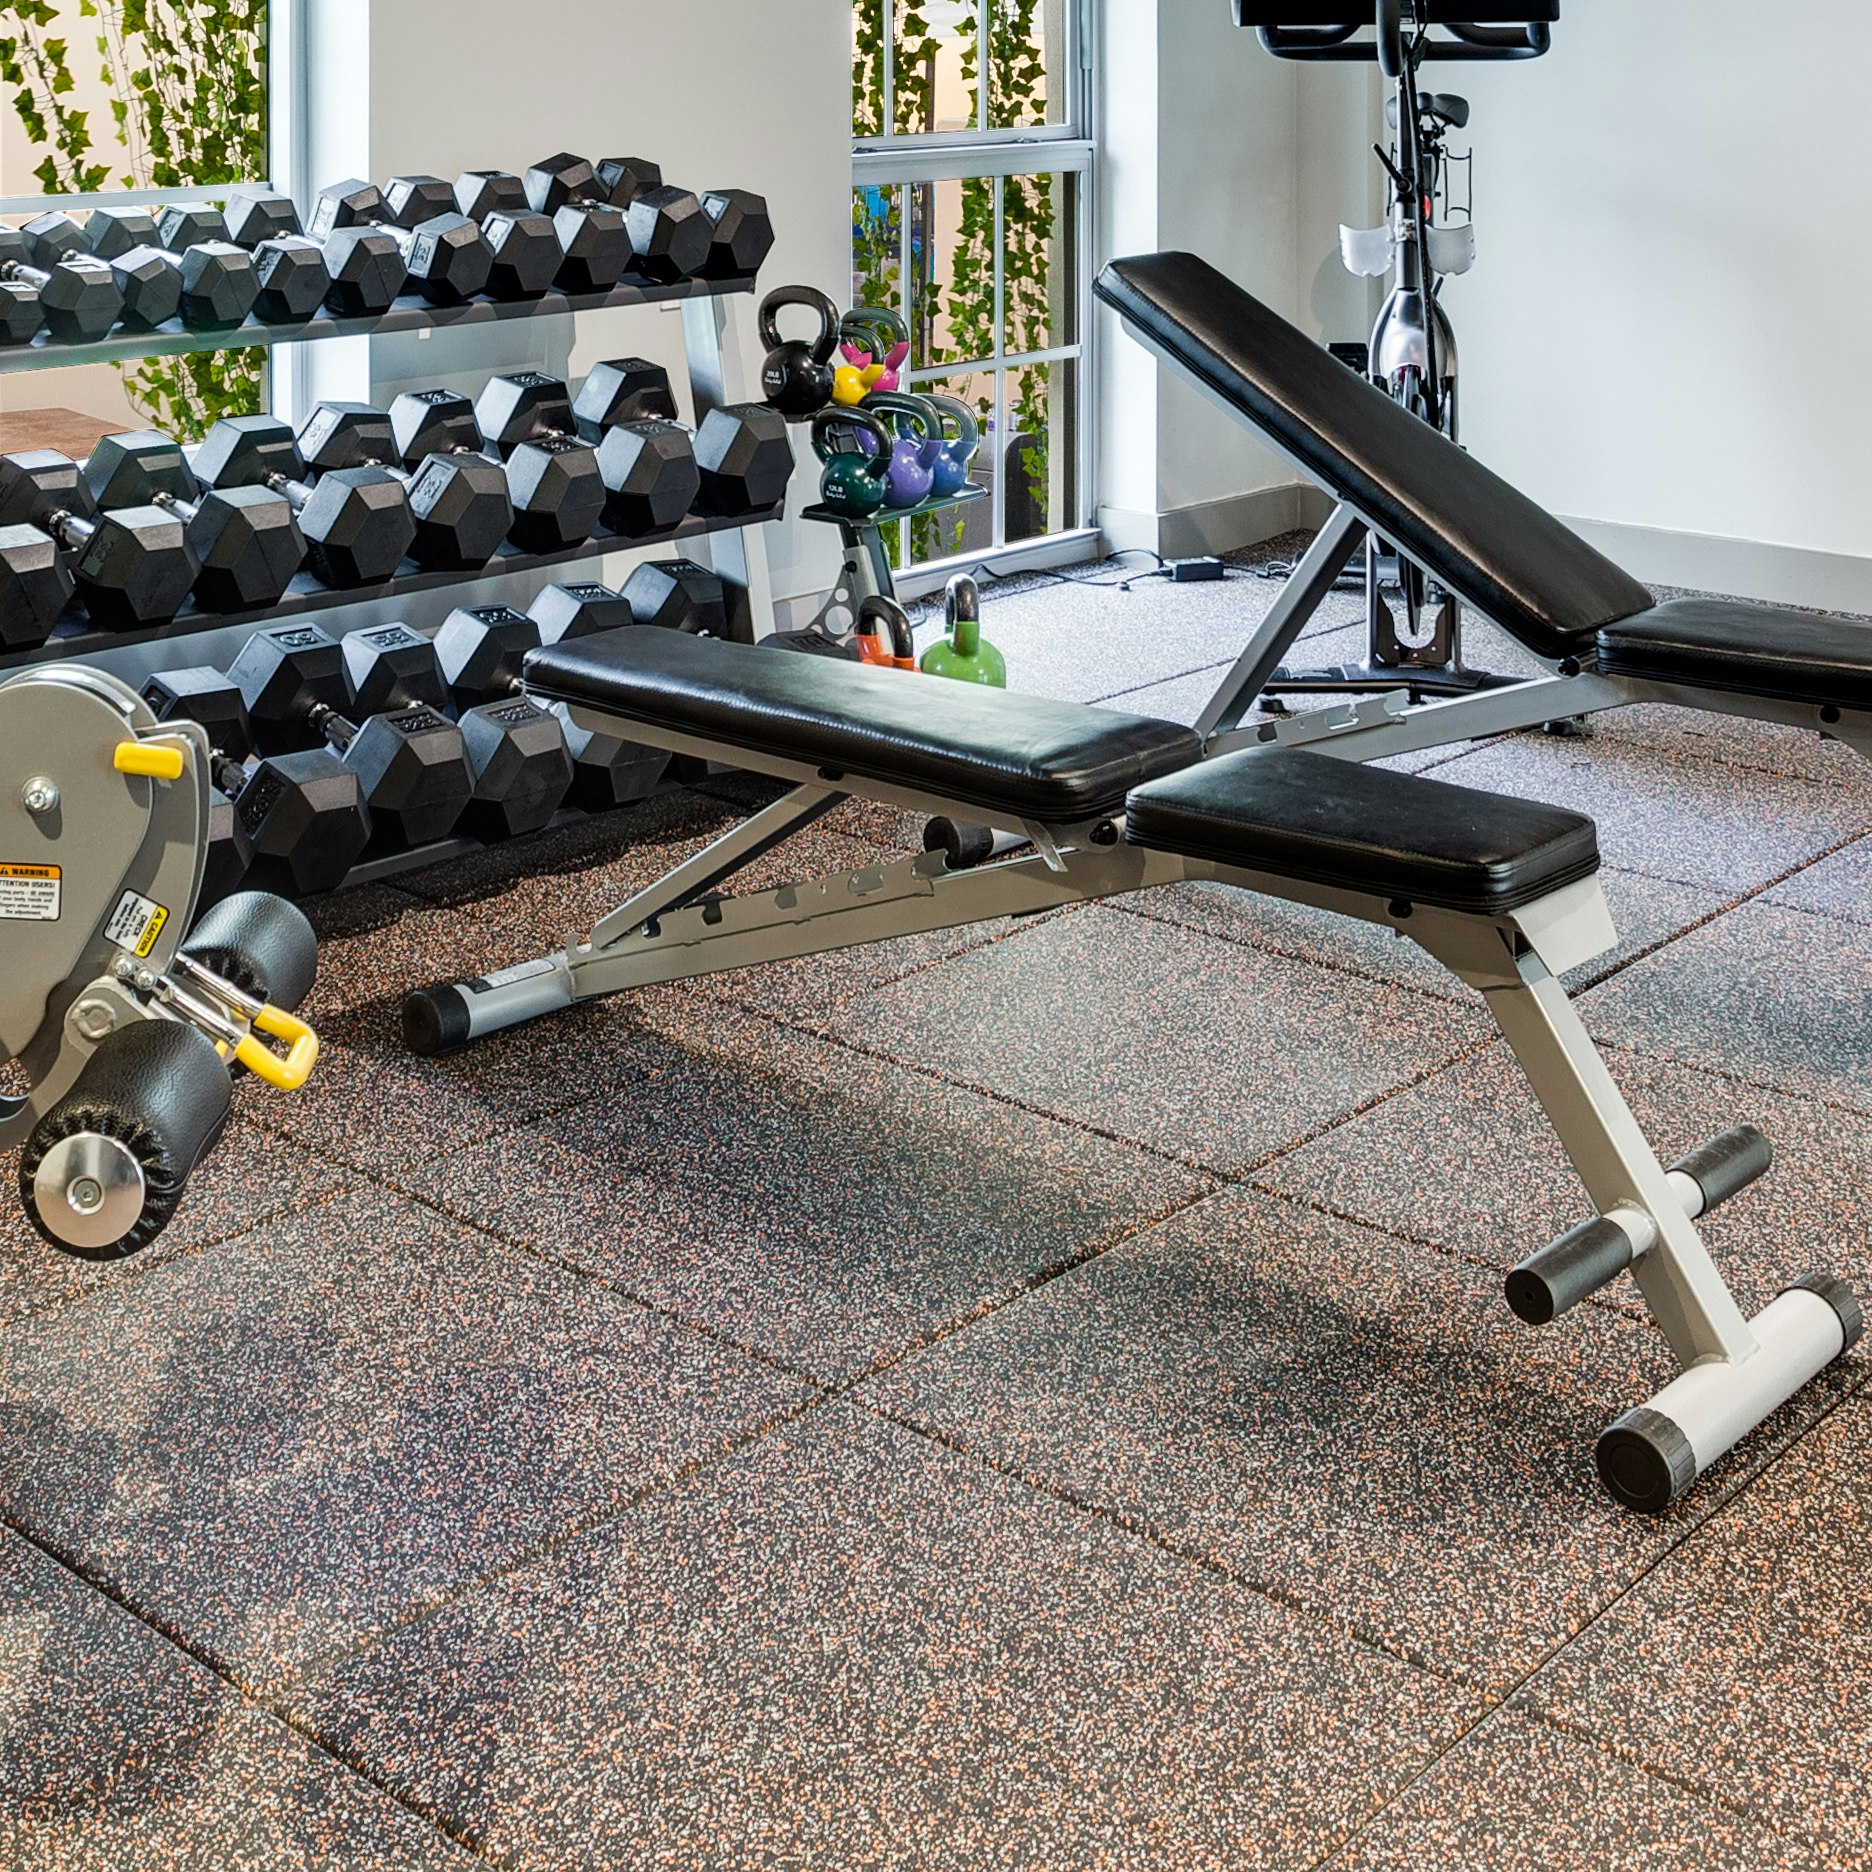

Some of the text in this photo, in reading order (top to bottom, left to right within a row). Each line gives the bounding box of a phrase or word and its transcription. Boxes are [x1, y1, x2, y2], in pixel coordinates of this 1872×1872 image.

[12, 868, 49, 877] WARNING
[132, 914, 148, 937] CHECK
[139, 922, 158, 952] CAUTION
